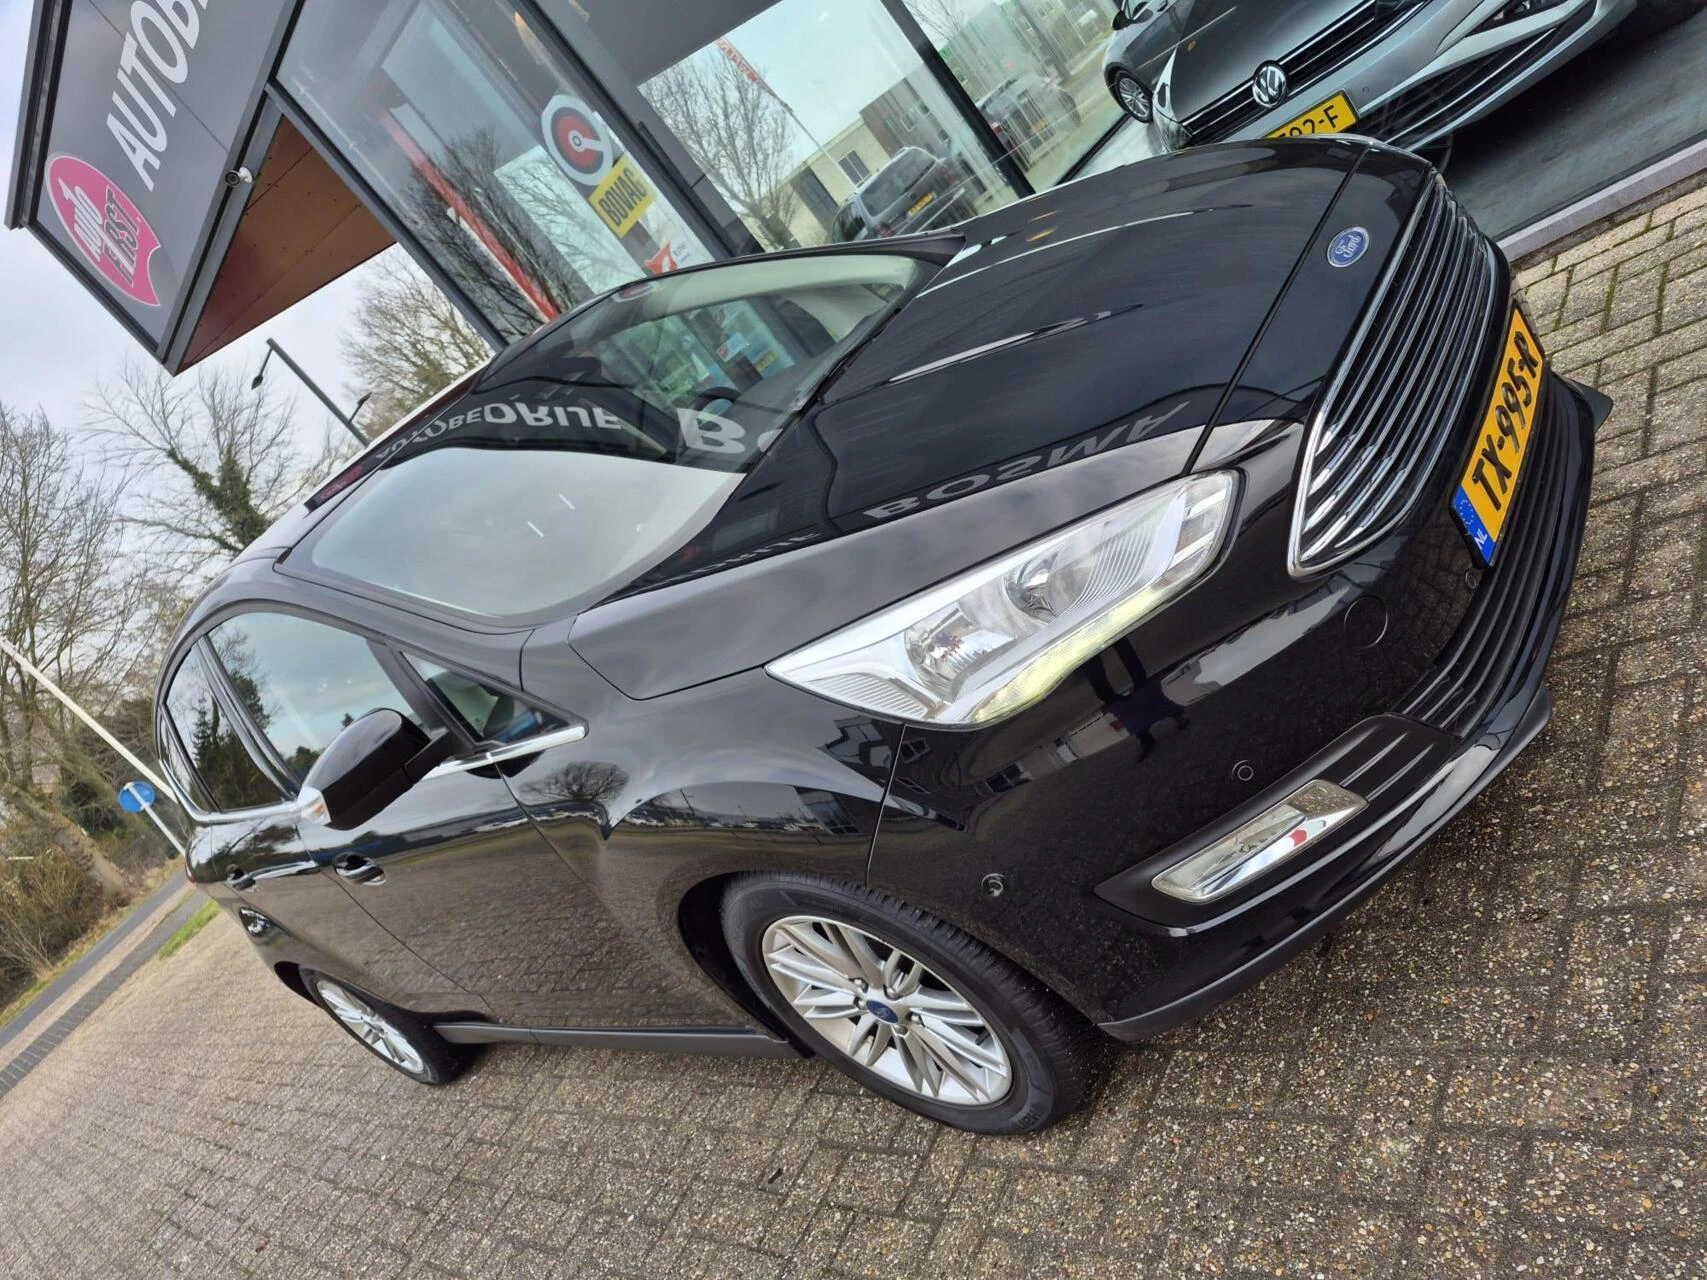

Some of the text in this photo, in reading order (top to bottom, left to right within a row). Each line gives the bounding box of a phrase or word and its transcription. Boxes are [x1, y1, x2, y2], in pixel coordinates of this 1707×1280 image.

[598, 167, 647, 227] BOVAG
[1334, 233, 1362, 259] Ford
[1471, 330, 1539, 511] TX-995-R
[1474, 527, 1488, 550] NL
